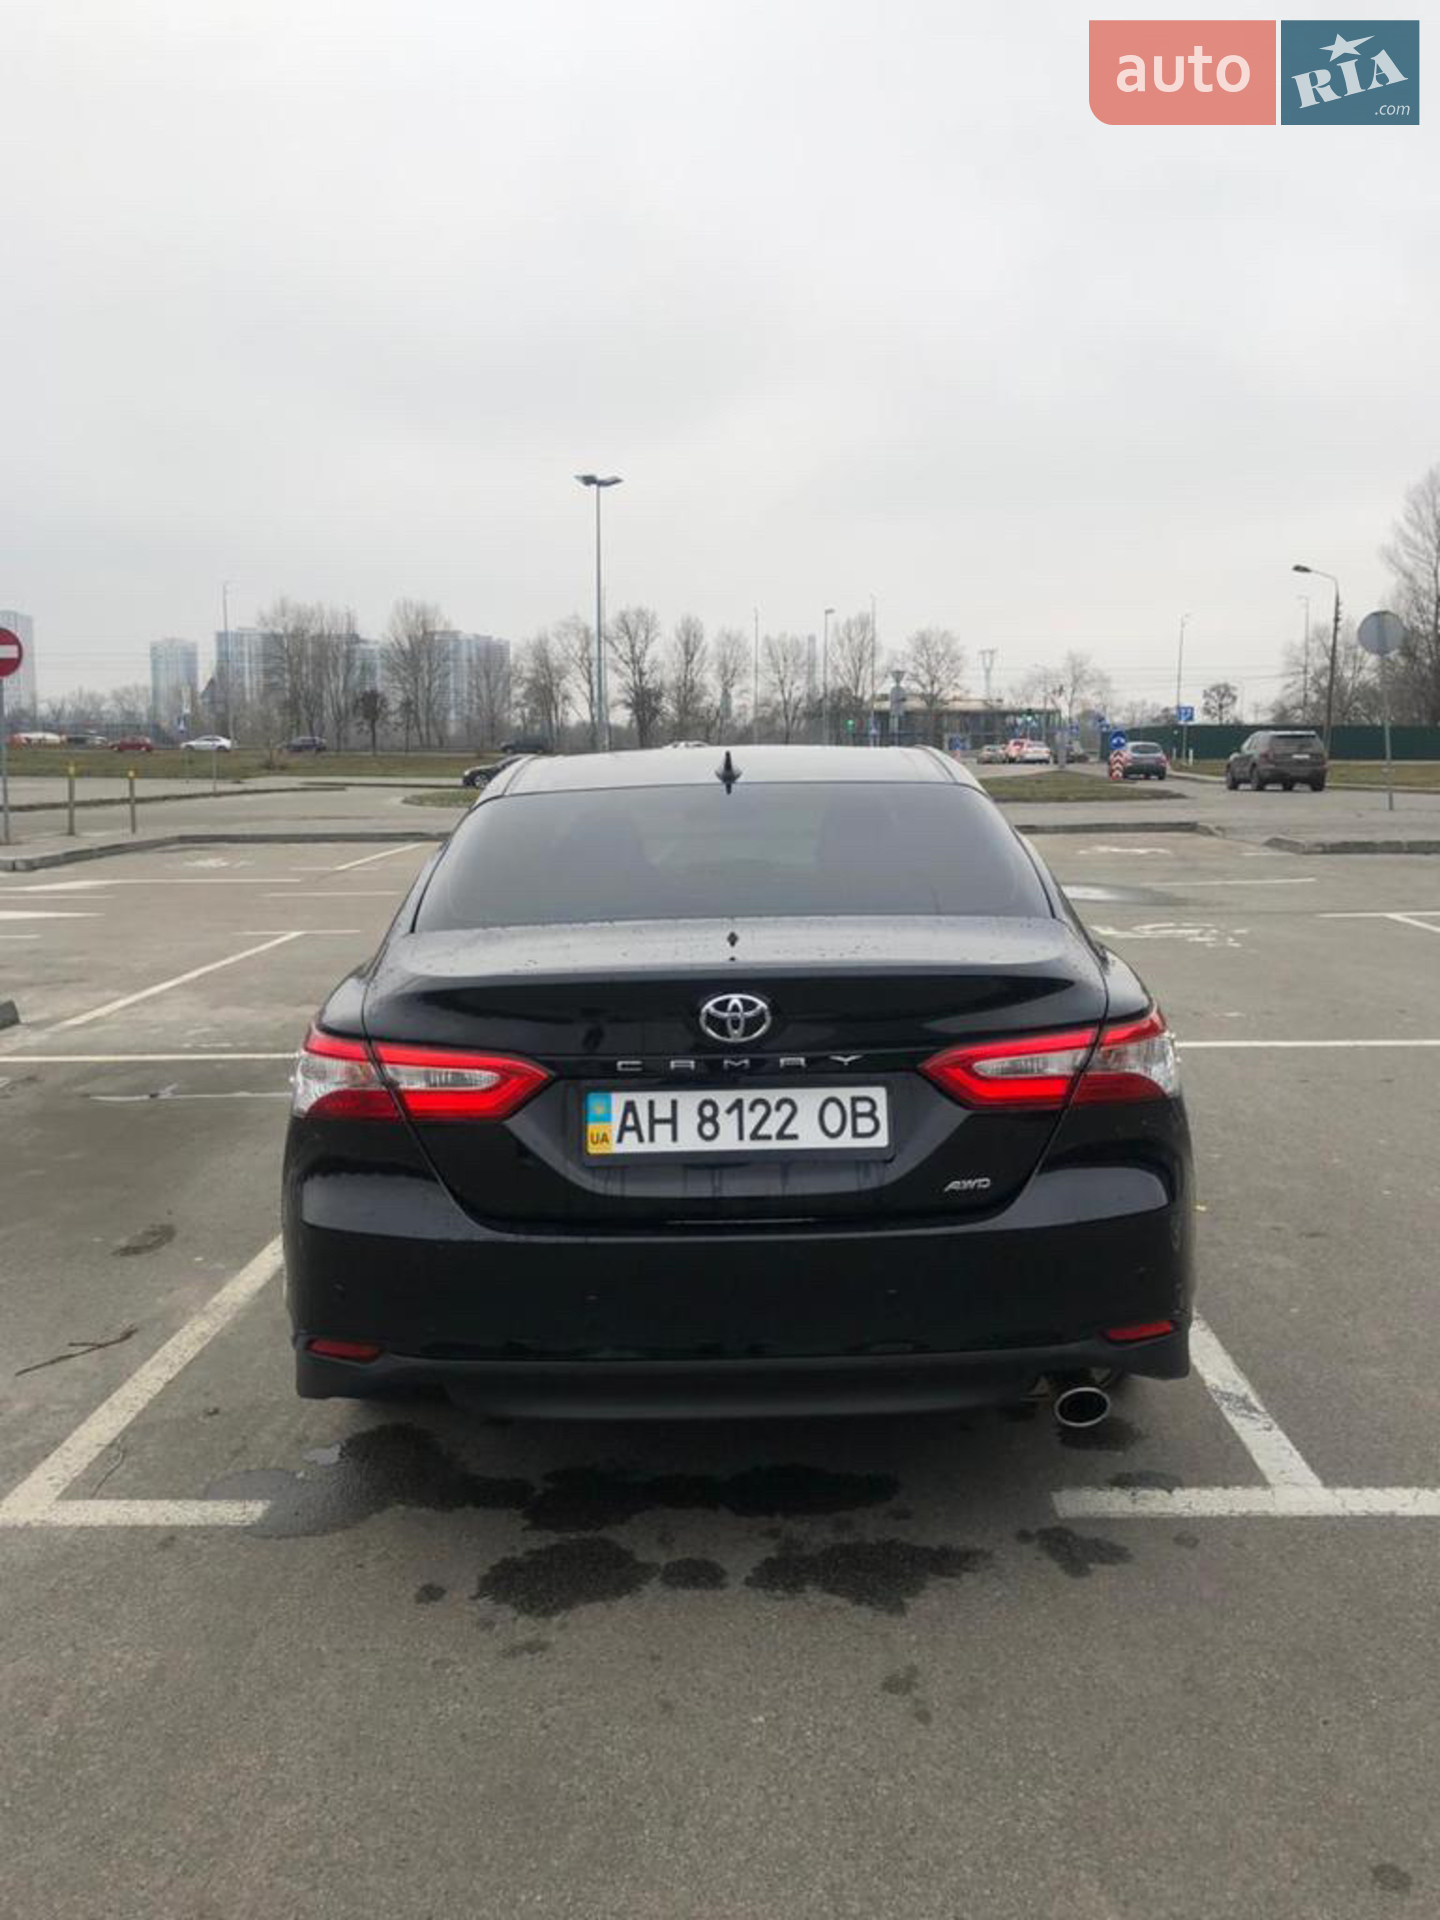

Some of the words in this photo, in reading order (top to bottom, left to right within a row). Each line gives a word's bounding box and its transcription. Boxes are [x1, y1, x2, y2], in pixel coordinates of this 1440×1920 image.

[616, 1055, 863, 1071] CAMRY
[616, 1099, 679, 1144] AH
[697, 1096, 799, 1142] 8122
[818, 1096, 881, 1139] OB
[590, 1131, 610, 1146] UA
[944, 1177, 991, 1193] AWD
